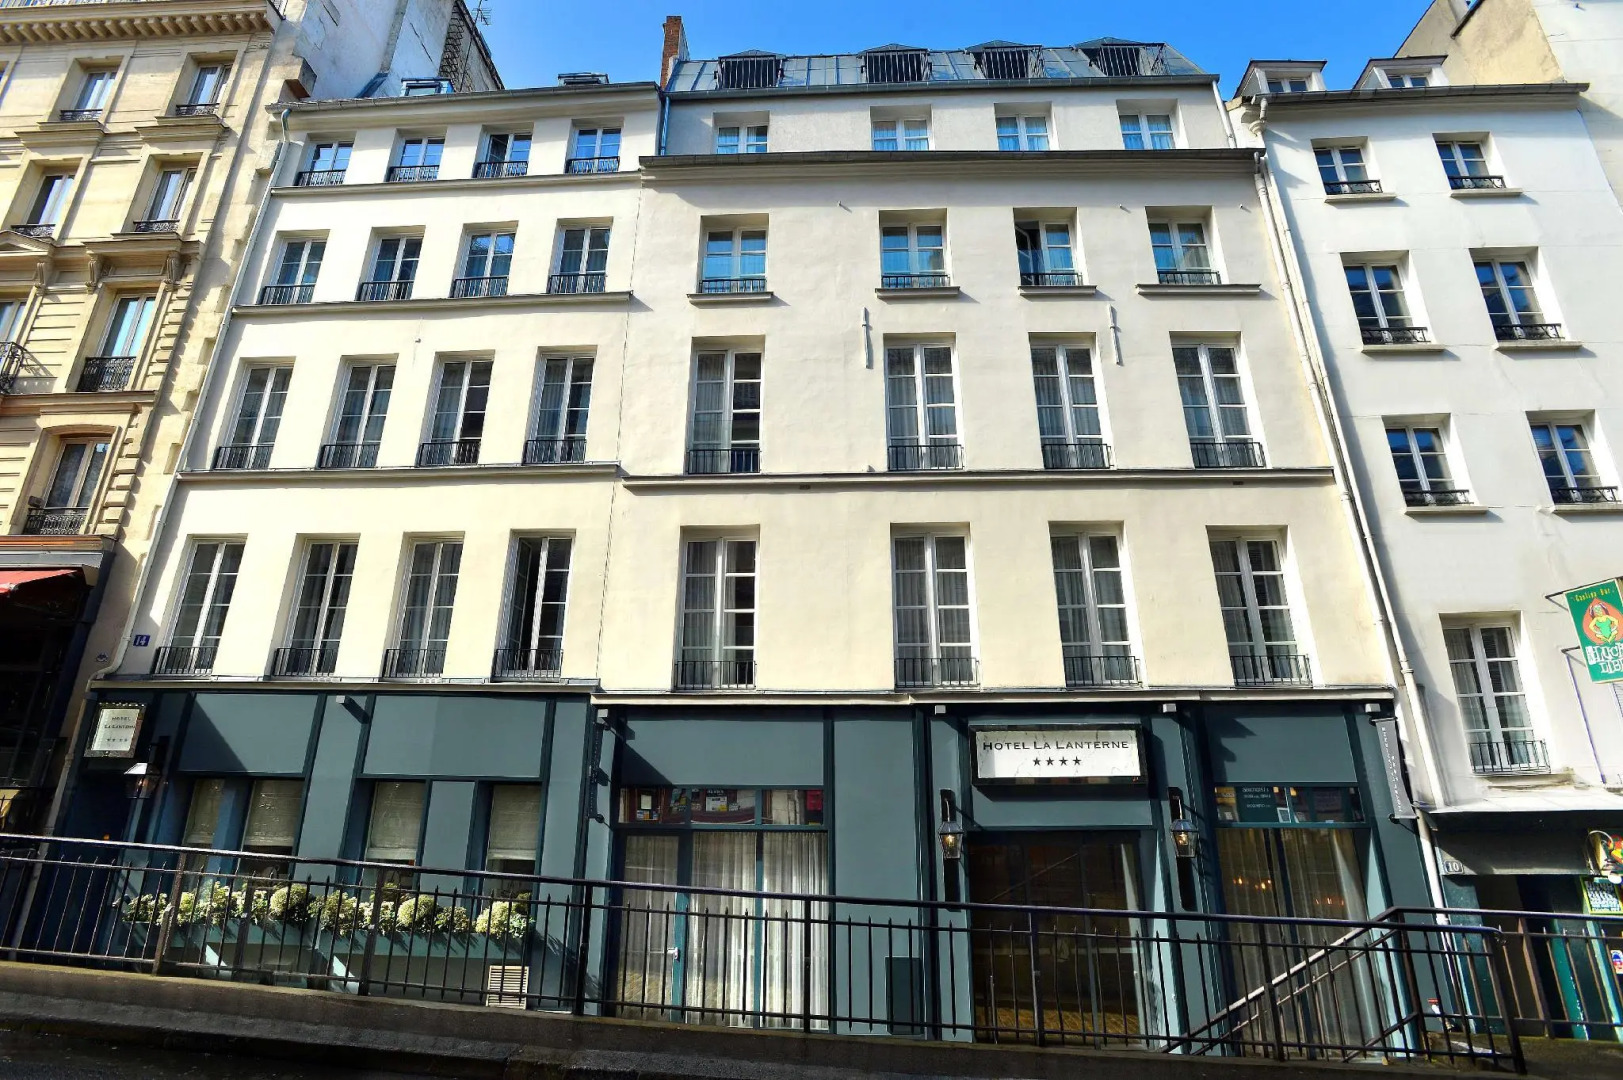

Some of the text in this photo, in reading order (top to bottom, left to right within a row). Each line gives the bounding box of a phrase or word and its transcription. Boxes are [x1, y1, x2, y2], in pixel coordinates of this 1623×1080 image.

[135, 635, 147, 646] 14
[983, 740, 1130, 750] HOTEL LA LANTERNE
[1447, 862, 1460, 872] 10
